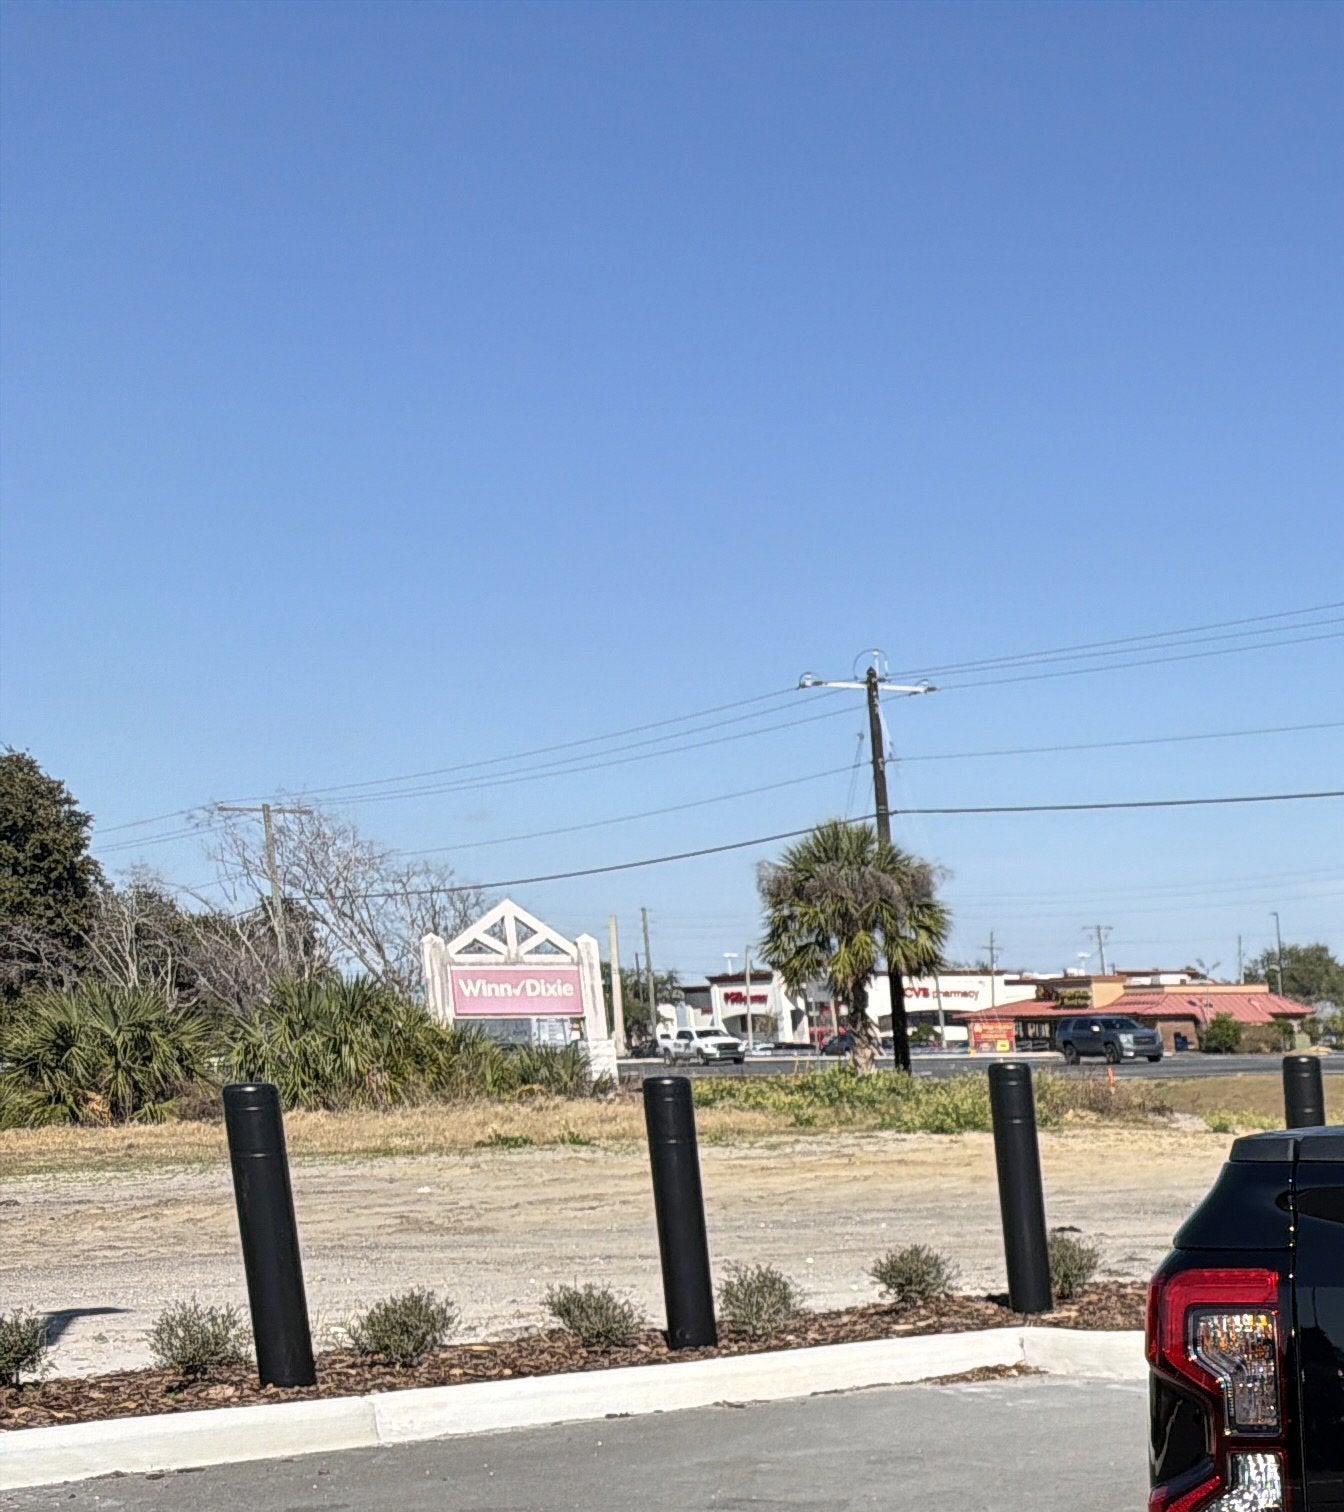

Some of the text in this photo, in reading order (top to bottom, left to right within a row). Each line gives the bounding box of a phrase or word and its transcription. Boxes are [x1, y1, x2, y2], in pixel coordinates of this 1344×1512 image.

[458, 979, 575, 997] Winn Dixie
[903, 987, 930, 999] CVS
